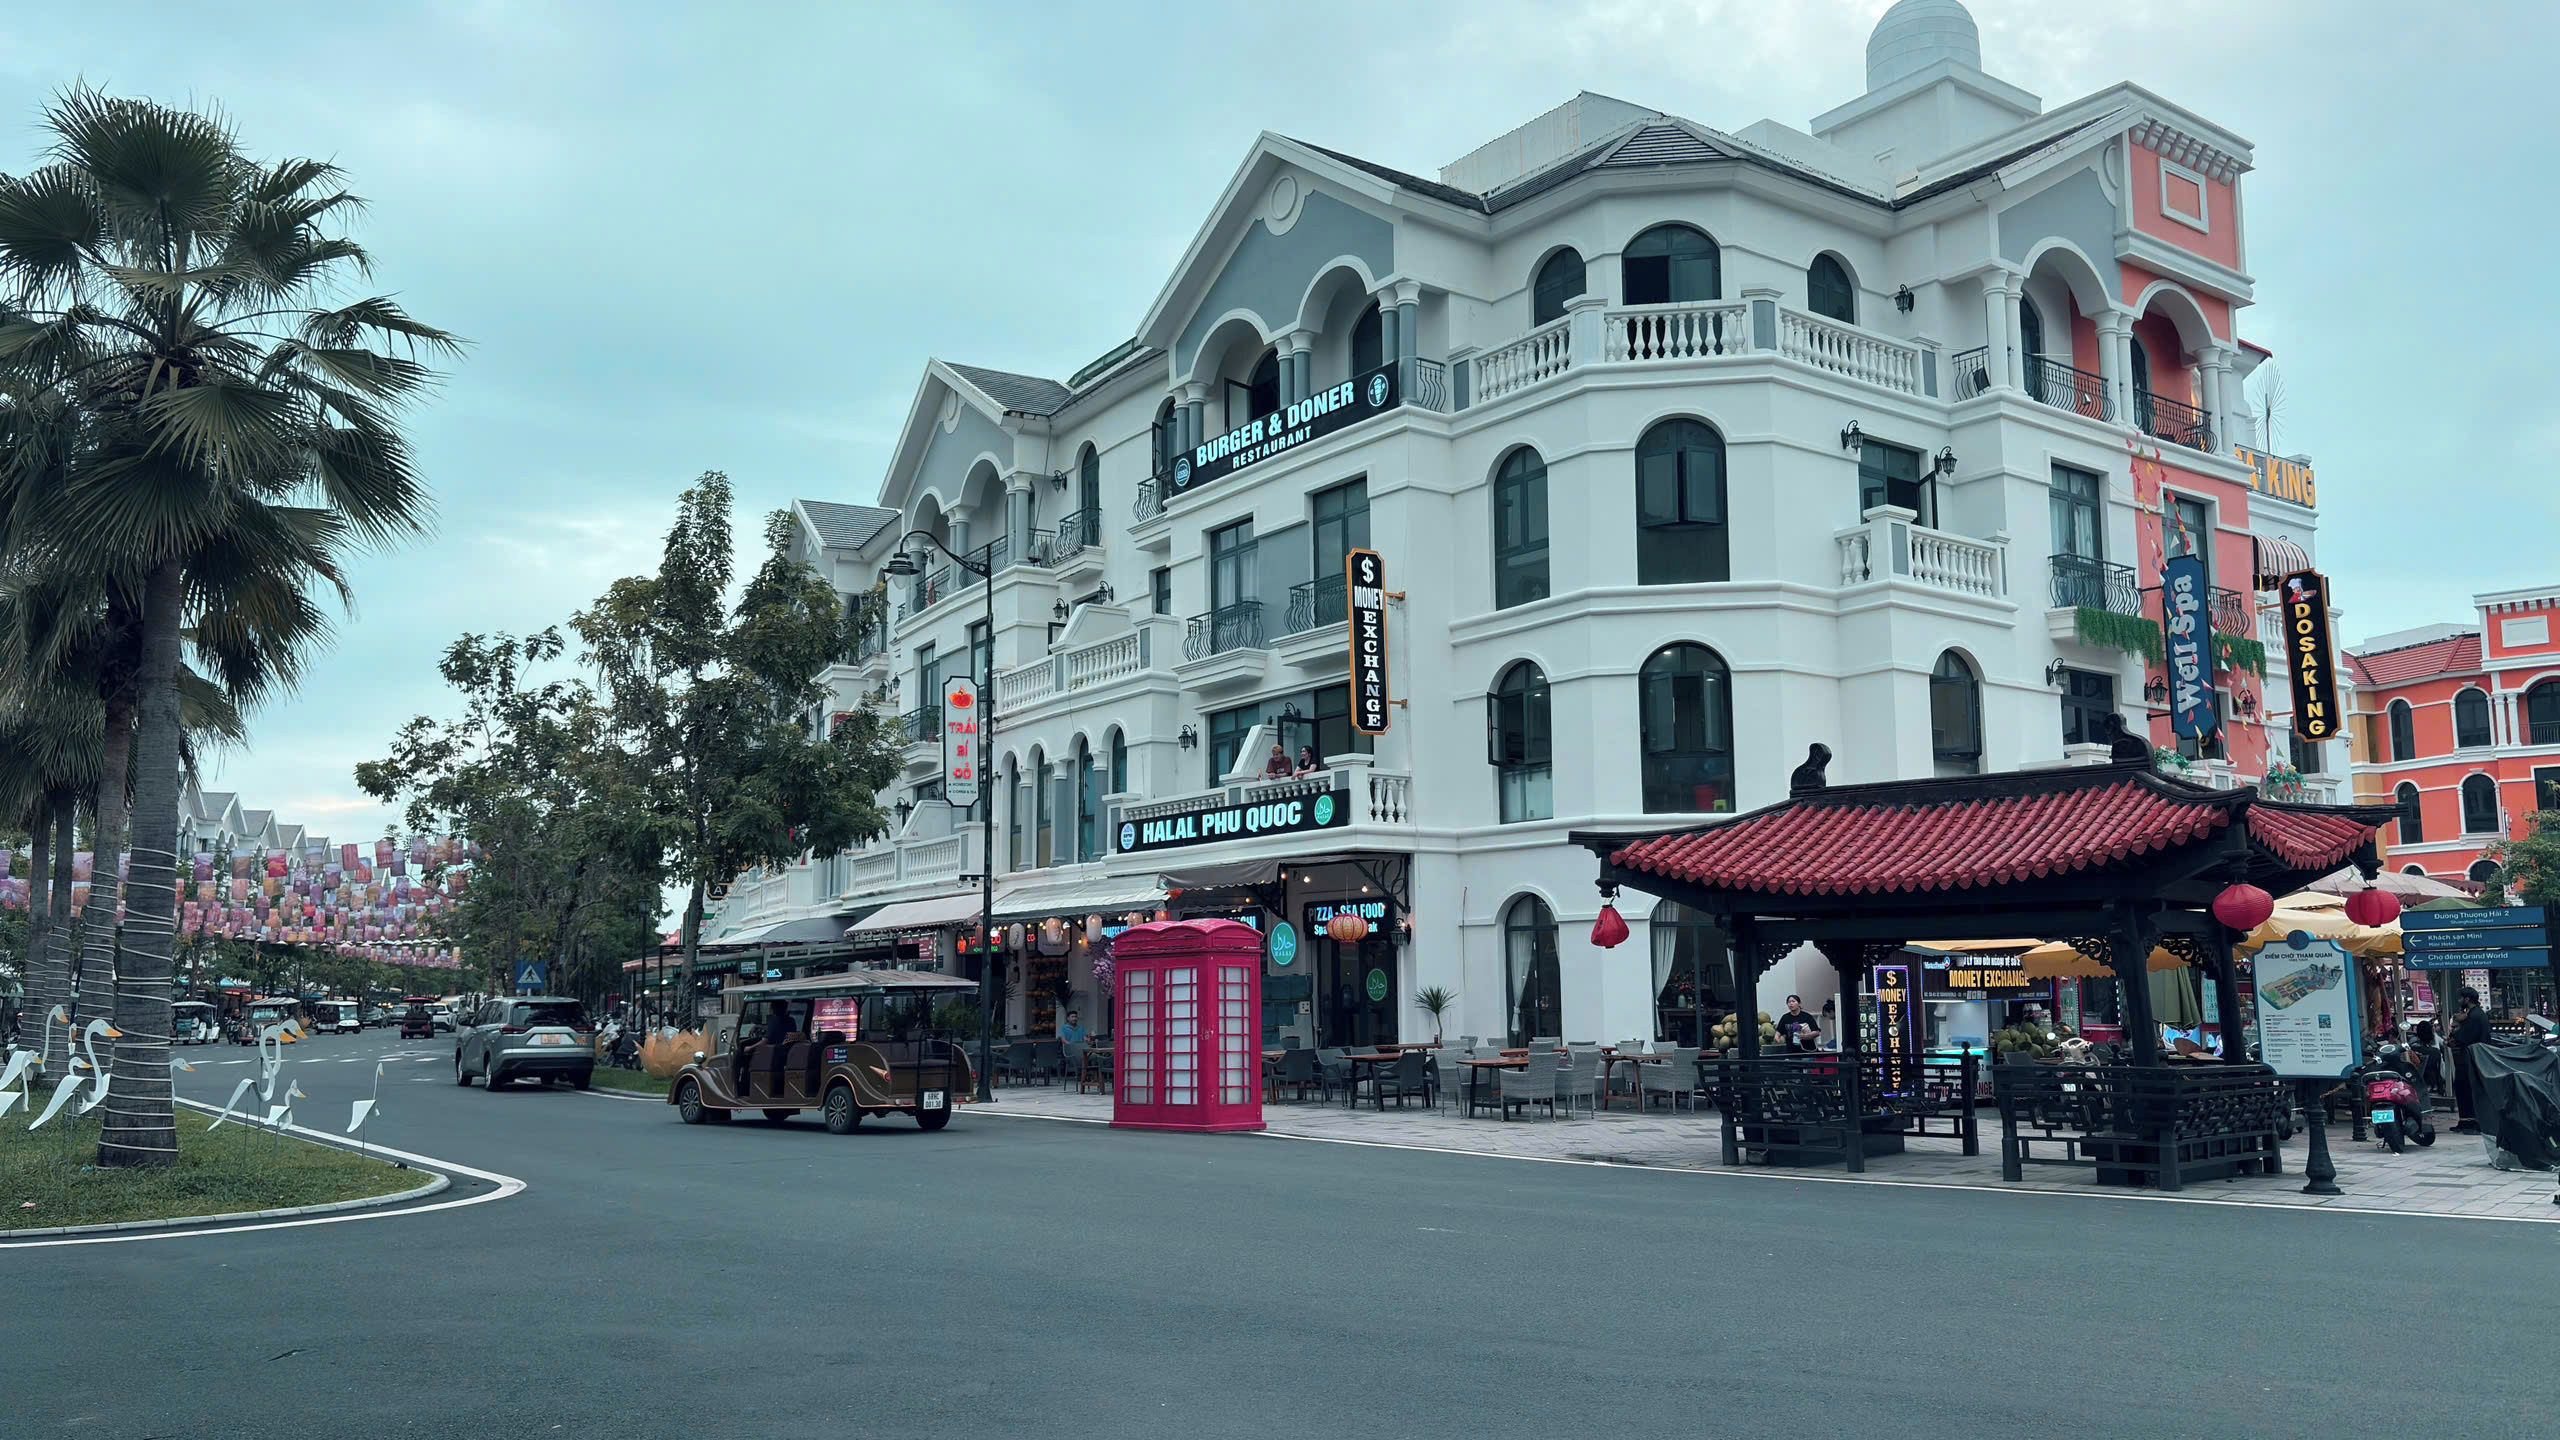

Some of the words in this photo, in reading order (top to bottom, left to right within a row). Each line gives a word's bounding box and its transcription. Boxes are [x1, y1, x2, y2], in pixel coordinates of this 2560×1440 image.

[1196, 421, 1263, 468] BURGER
[1268, 414, 1282, 436] &
[1287, 381, 1354, 428] DONER
[1232, 426, 1312, 469] RESTAURANT
[2267, 456, 2315, 507] KING
[1354, 585, 1383, 610] MONEY
[2171, 574, 2199, 635] Spa
[1363, 611, 1381, 727] EXCHANGE
[2174, 641, 2201, 712] Well
[2294, 603, 2326, 735] DOSAKING
[1143, 817, 1197, 844] HALAL
[1202, 810, 1241, 837] PHU
[1246, 801, 1302, 832] QUOC
[1308, 906, 1334, 922] PIZZA
[1360, 902, 1385, 919] FOOD
[1878, 988, 1906, 1002] MONEY
[1949, 970, 1981, 987] MONEY
